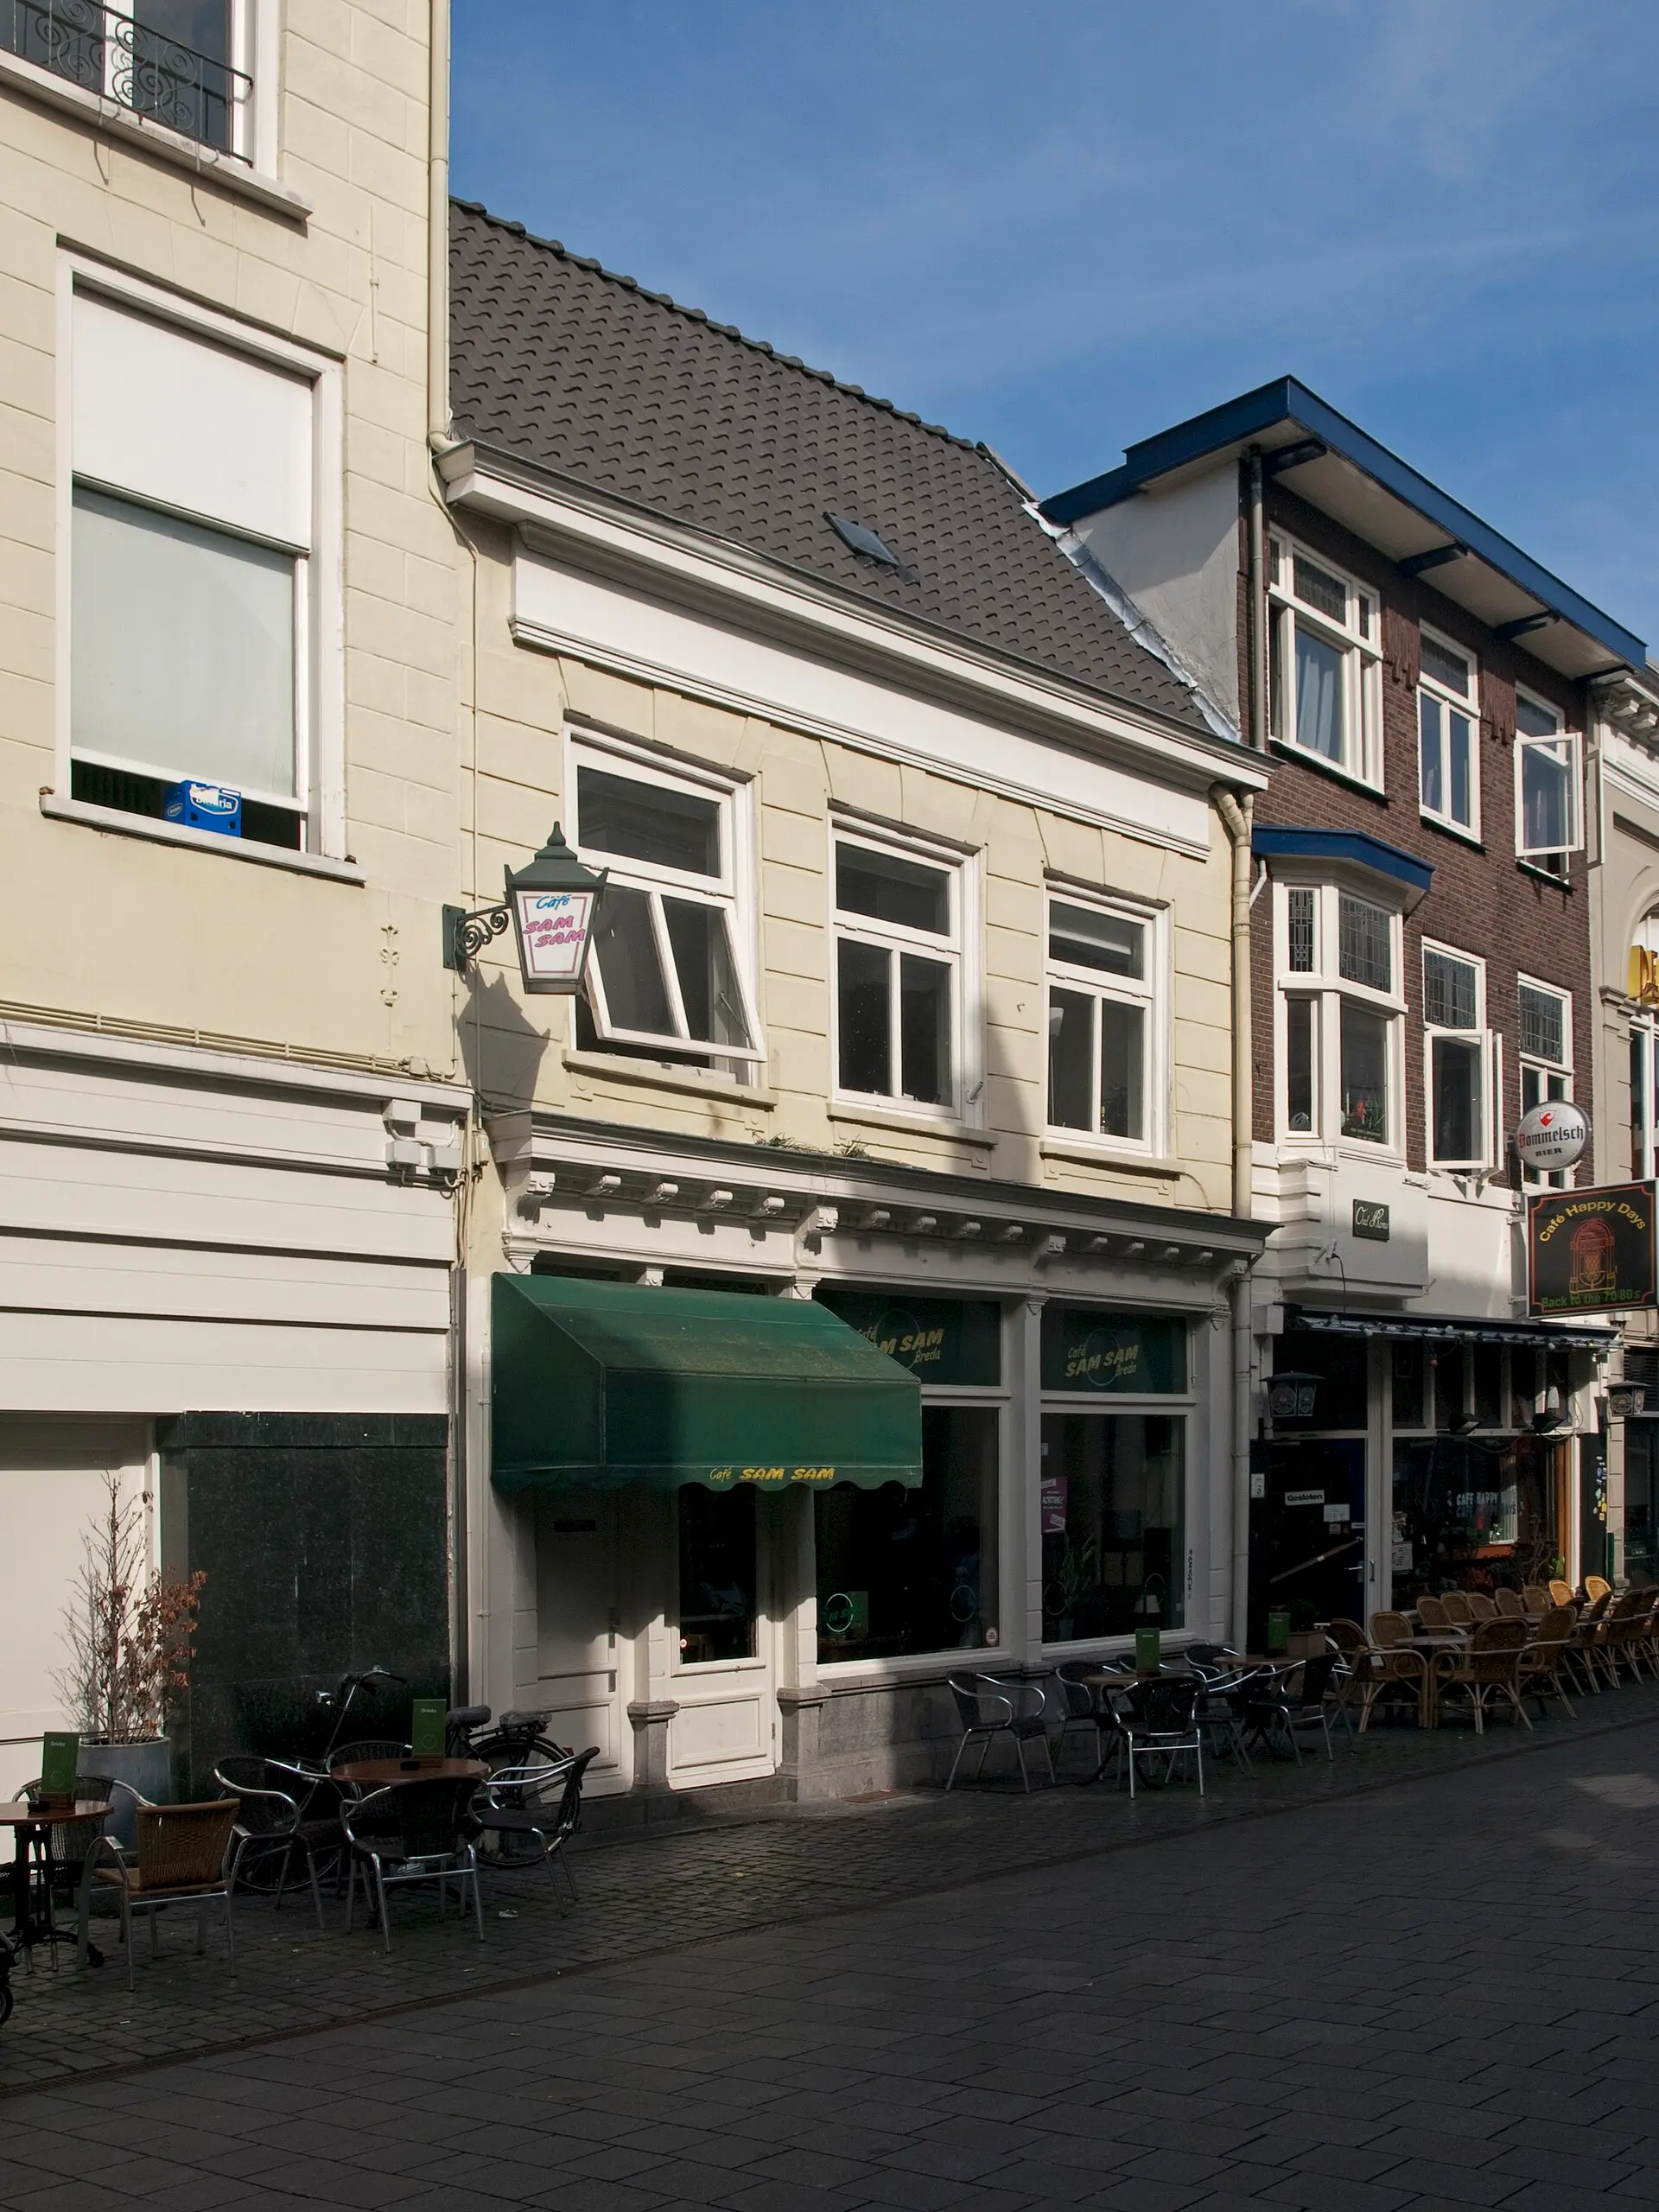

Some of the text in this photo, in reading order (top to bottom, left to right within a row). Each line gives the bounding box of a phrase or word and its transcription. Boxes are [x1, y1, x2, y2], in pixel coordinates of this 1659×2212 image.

[536, 894, 572, 911] Café
[523, 915, 575, 934] SAM
[535, 929, 586, 948] SAM
[1518, 1125, 1584, 1148] Dommelsch
[1535, 1147, 1562, 1157] BIER
[1539, 1201, 1646, 1242] Café Happy Days
[1541, 1296, 1567, 1308] Back
[1570, 1295, 1580, 1305] to
[1584, 1293, 1601, 1304] the
[899, 1327, 944, 1351] SAM
[916, 1346, 941, 1363] Breda
[1065, 1344, 1139, 1377] SAM SAM
[1116, 1361, 1137, 1376] Breda
[709, 1466, 836, 1483] Café SAM SAM
[1287, 1493, 1323, 1502] Gesloten
